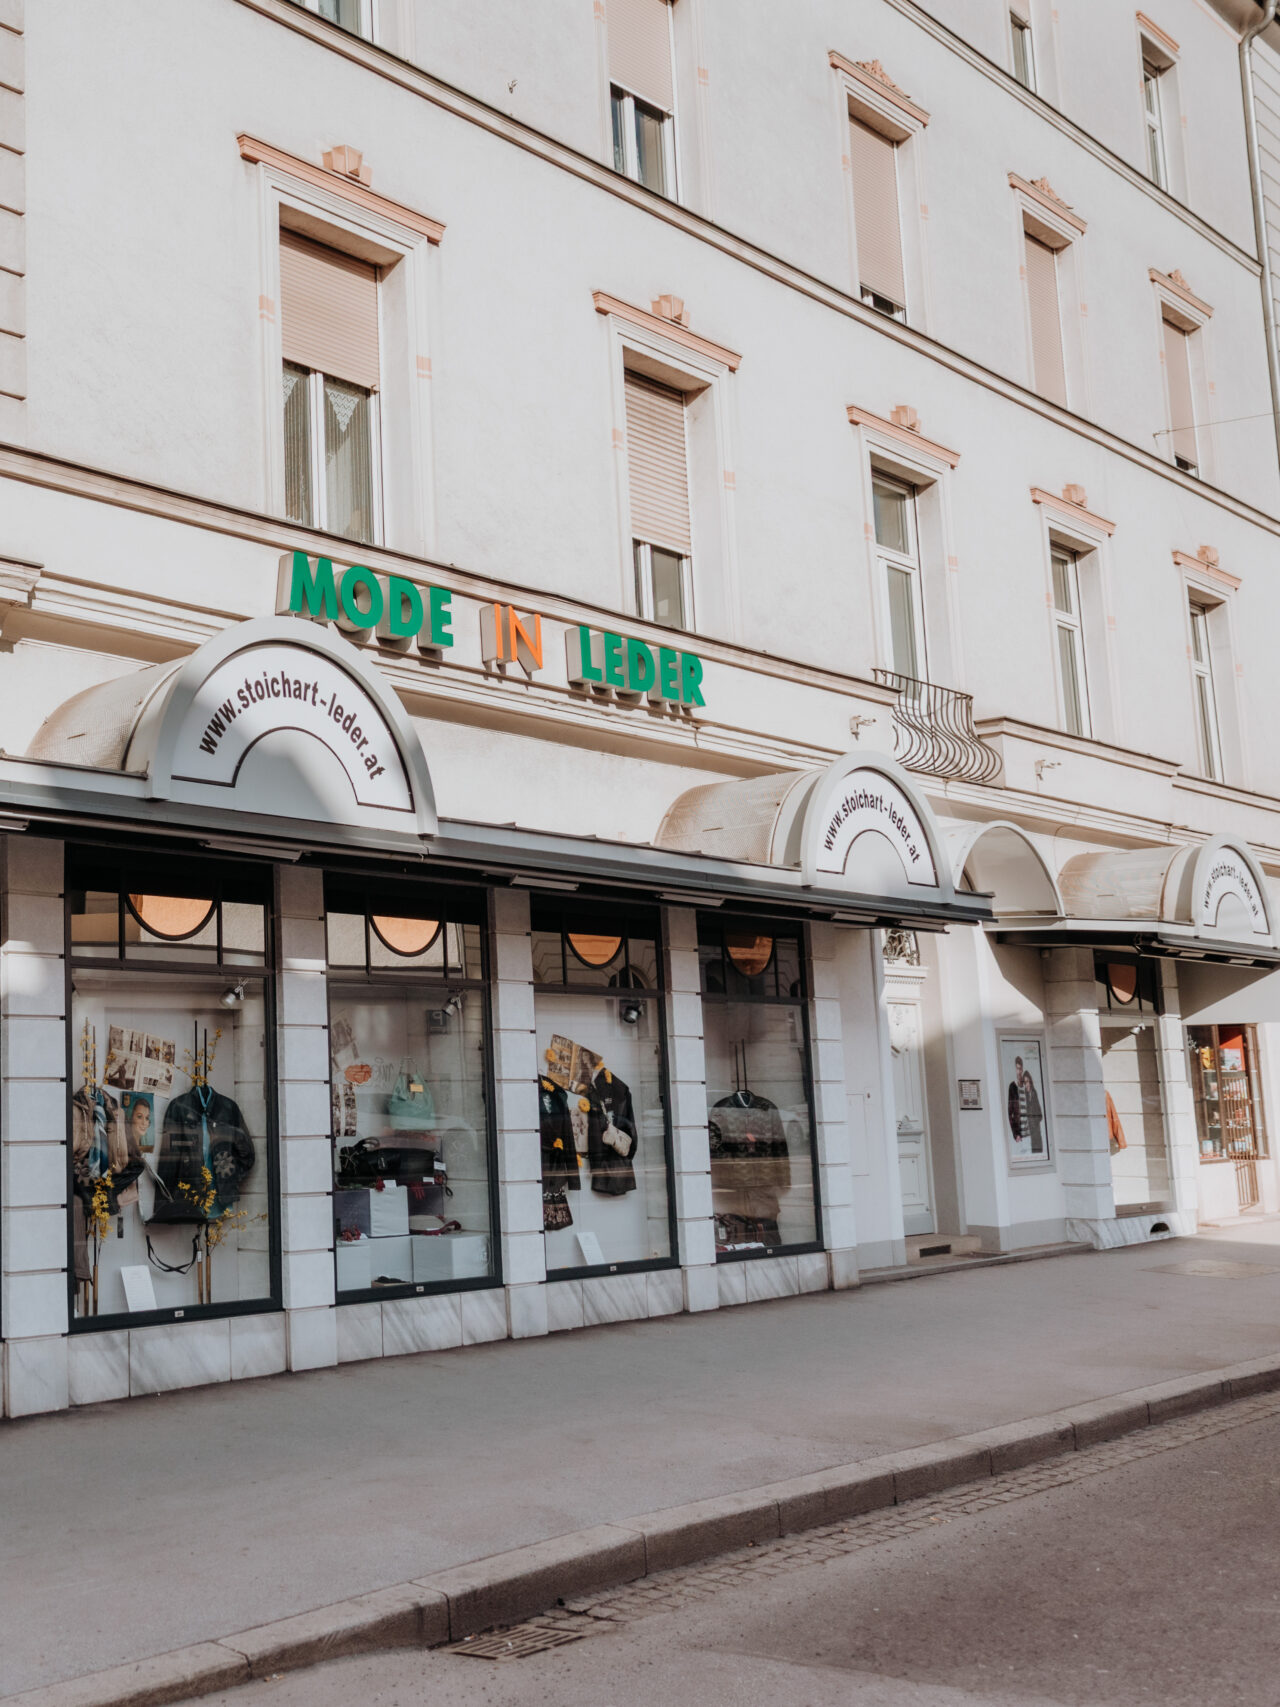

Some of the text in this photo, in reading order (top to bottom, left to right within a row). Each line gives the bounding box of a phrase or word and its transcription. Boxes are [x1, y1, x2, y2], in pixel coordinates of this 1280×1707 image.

[289, 550, 706, 706] MODE IN LEDER
[199, 670, 386, 781] www.stoichart-leder.at
[824, 788, 921, 864] www.stoichart-leder.at
